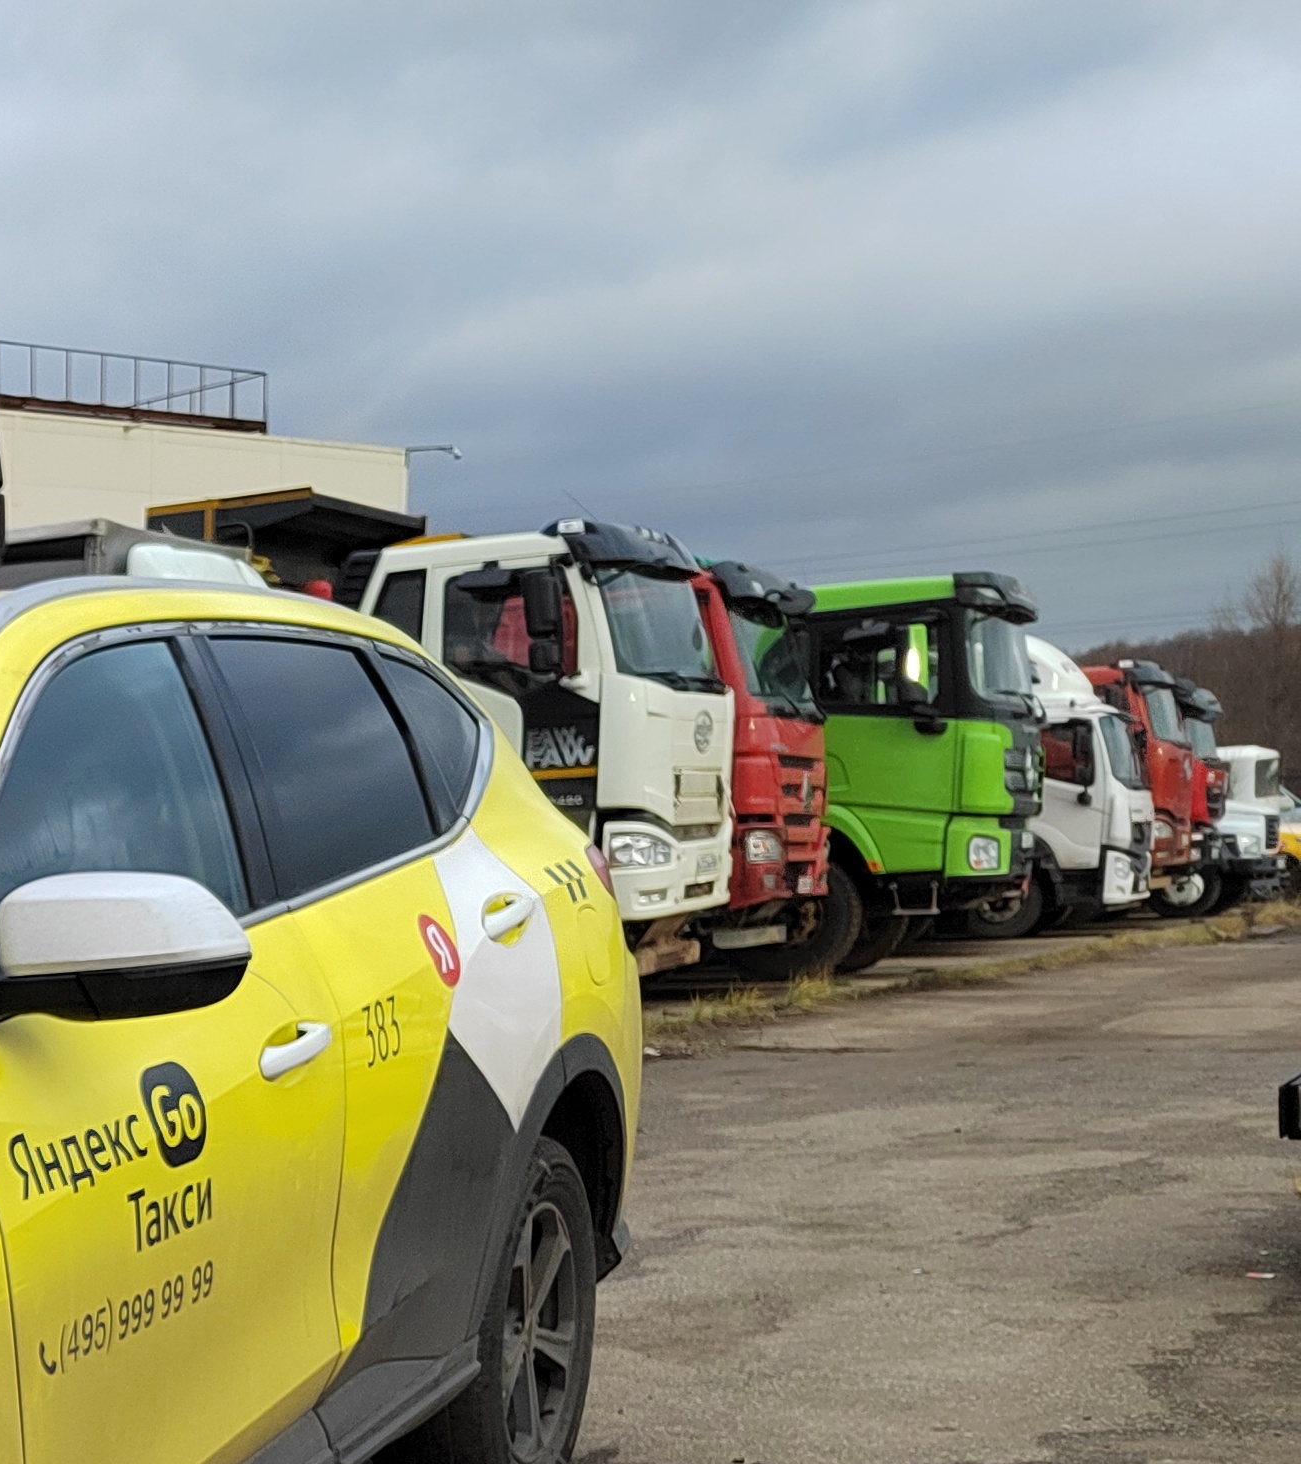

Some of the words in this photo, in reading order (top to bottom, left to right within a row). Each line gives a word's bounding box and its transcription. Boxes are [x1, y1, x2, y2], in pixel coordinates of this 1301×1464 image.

[426, 923, 455, 974] Я
[362, 996, 401, 1068] 383
[8, 1114, 148, 1201] Яндекс
[150, 1084, 203, 1149] Go
[127, 1177, 213, 1253] Такси
[60, 1296, 113, 1374] (495)
[118, 1288, 155, 1341] 999
[161, 1274, 184, 1319] 99
[191, 1260, 213, 1304] 99
